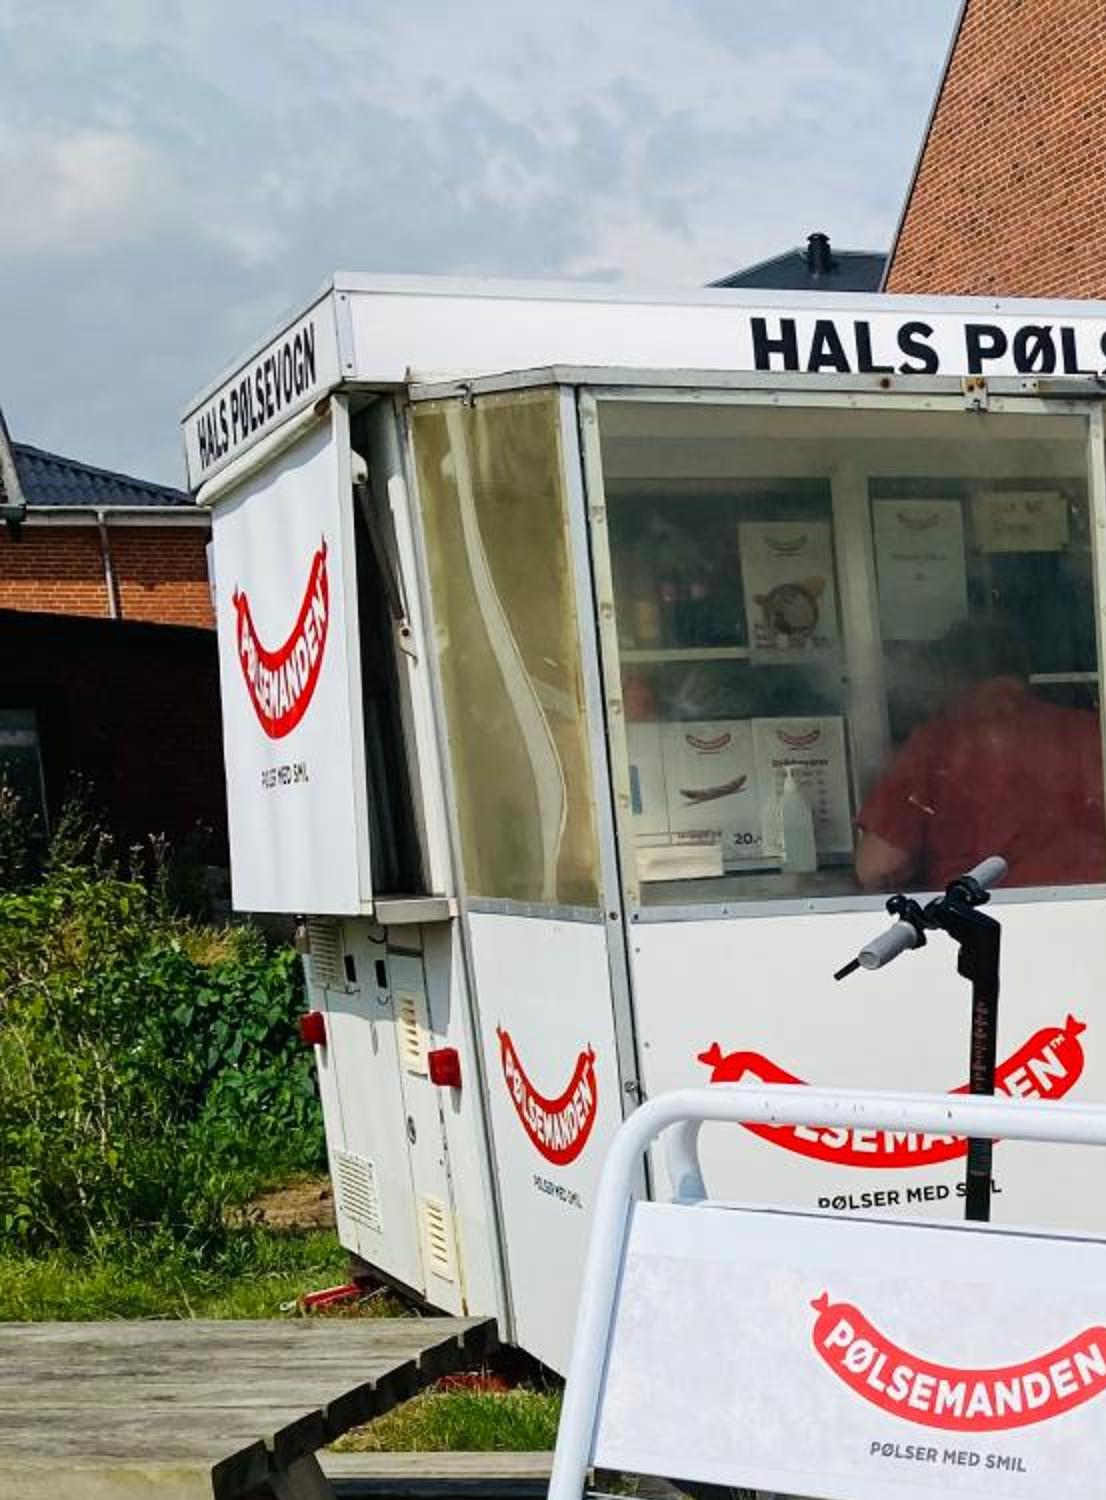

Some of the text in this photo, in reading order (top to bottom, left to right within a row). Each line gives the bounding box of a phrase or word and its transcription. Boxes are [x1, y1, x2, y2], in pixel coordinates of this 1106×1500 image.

[750, 317, 940, 375] HALS
[197, 322, 316, 470] HALS PØLSEVOGN
[907, 1184, 950, 1203] MED
[956, 1178, 1002, 1198] SL
[870, 1441, 1027, 1473] PØLSER MED SMIL
